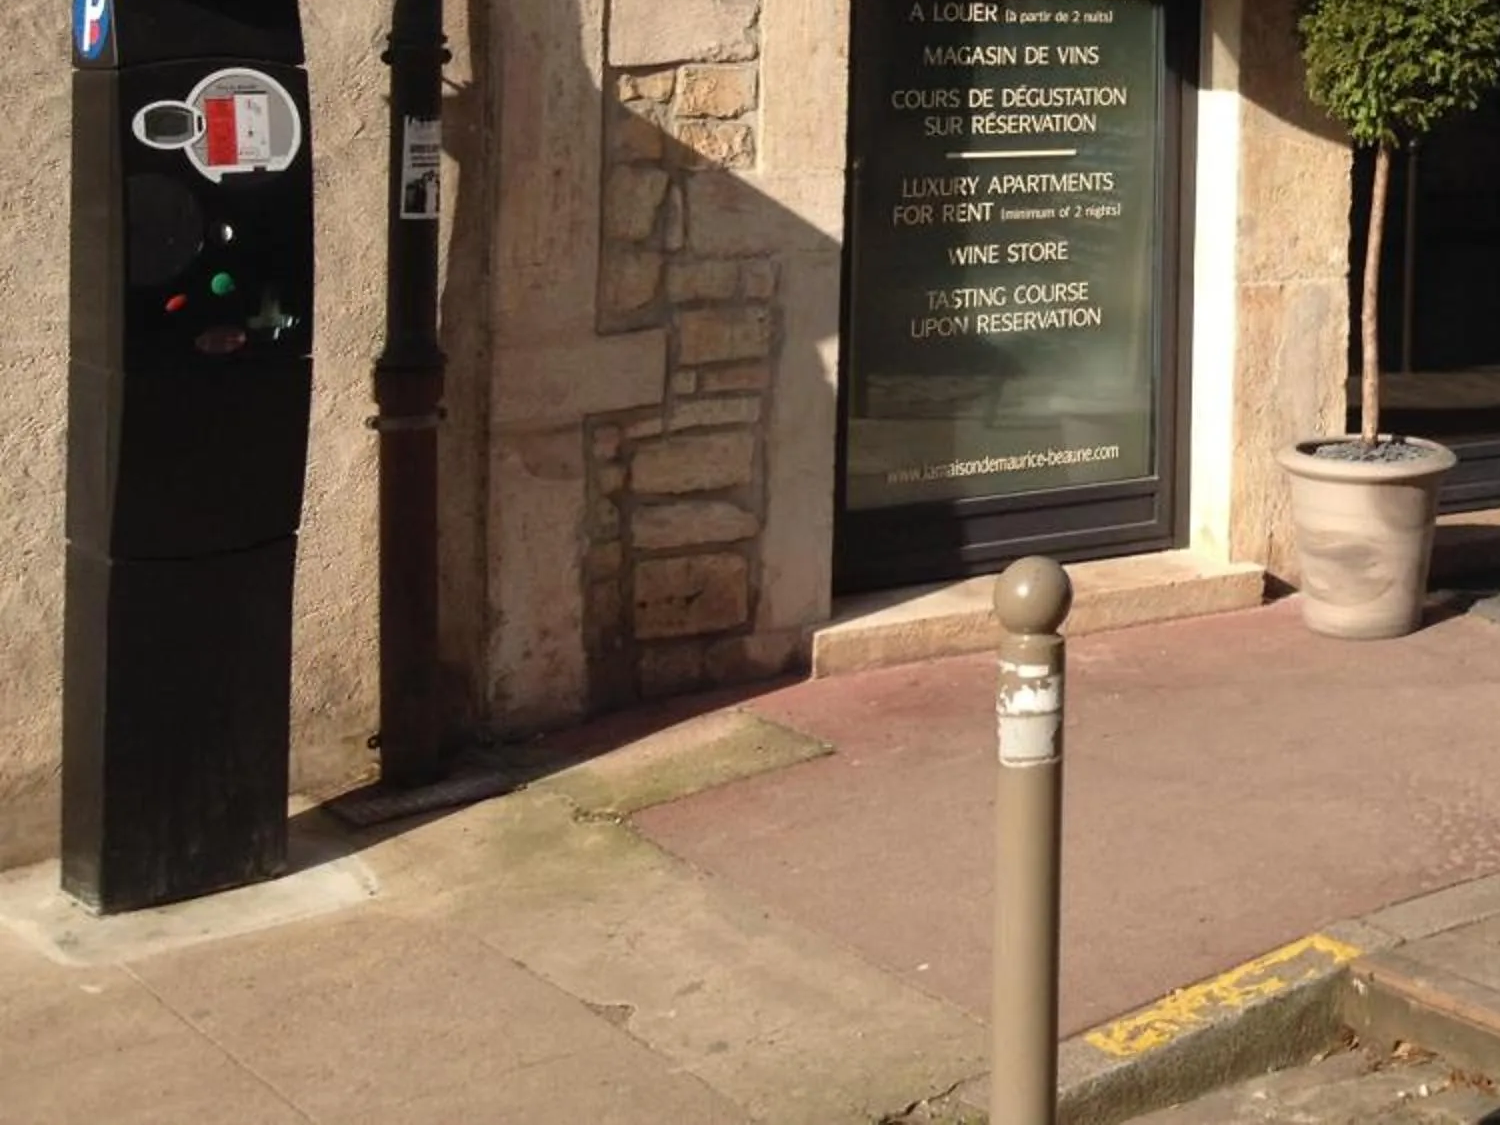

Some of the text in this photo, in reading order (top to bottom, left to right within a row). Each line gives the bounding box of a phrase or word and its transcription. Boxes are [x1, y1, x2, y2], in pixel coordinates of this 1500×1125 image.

[908, 3, 925, 23] A
[933, 2, 998, 23] LOUER
[1019, 10, 1052, 25] partir
[1054, 10, 1069, 24] de
[1071, 11, 1081, 24] 2
[922, 45, 1100, 67] MAGASIN DE VINS
[891, 84, 1128, 110] COURS DE DÉGUSTATION
[923, 111, 1097, 137] SUR RÉSERVATION
[902, 172, 1114, 198] LUXURY APARTMENTS
[893, 205, 933, 226] FOR
[943, 202, 994, 223] RENT
[1059, 206, 1071, 219] of
[1074, 207, 1081, 219] 2
[949, 241, 1069, 266] WINE STORE
[926, 282, 1089, 311] TASTING COURSE
[910, 307, 1102, 339] UPON RESERVATION
